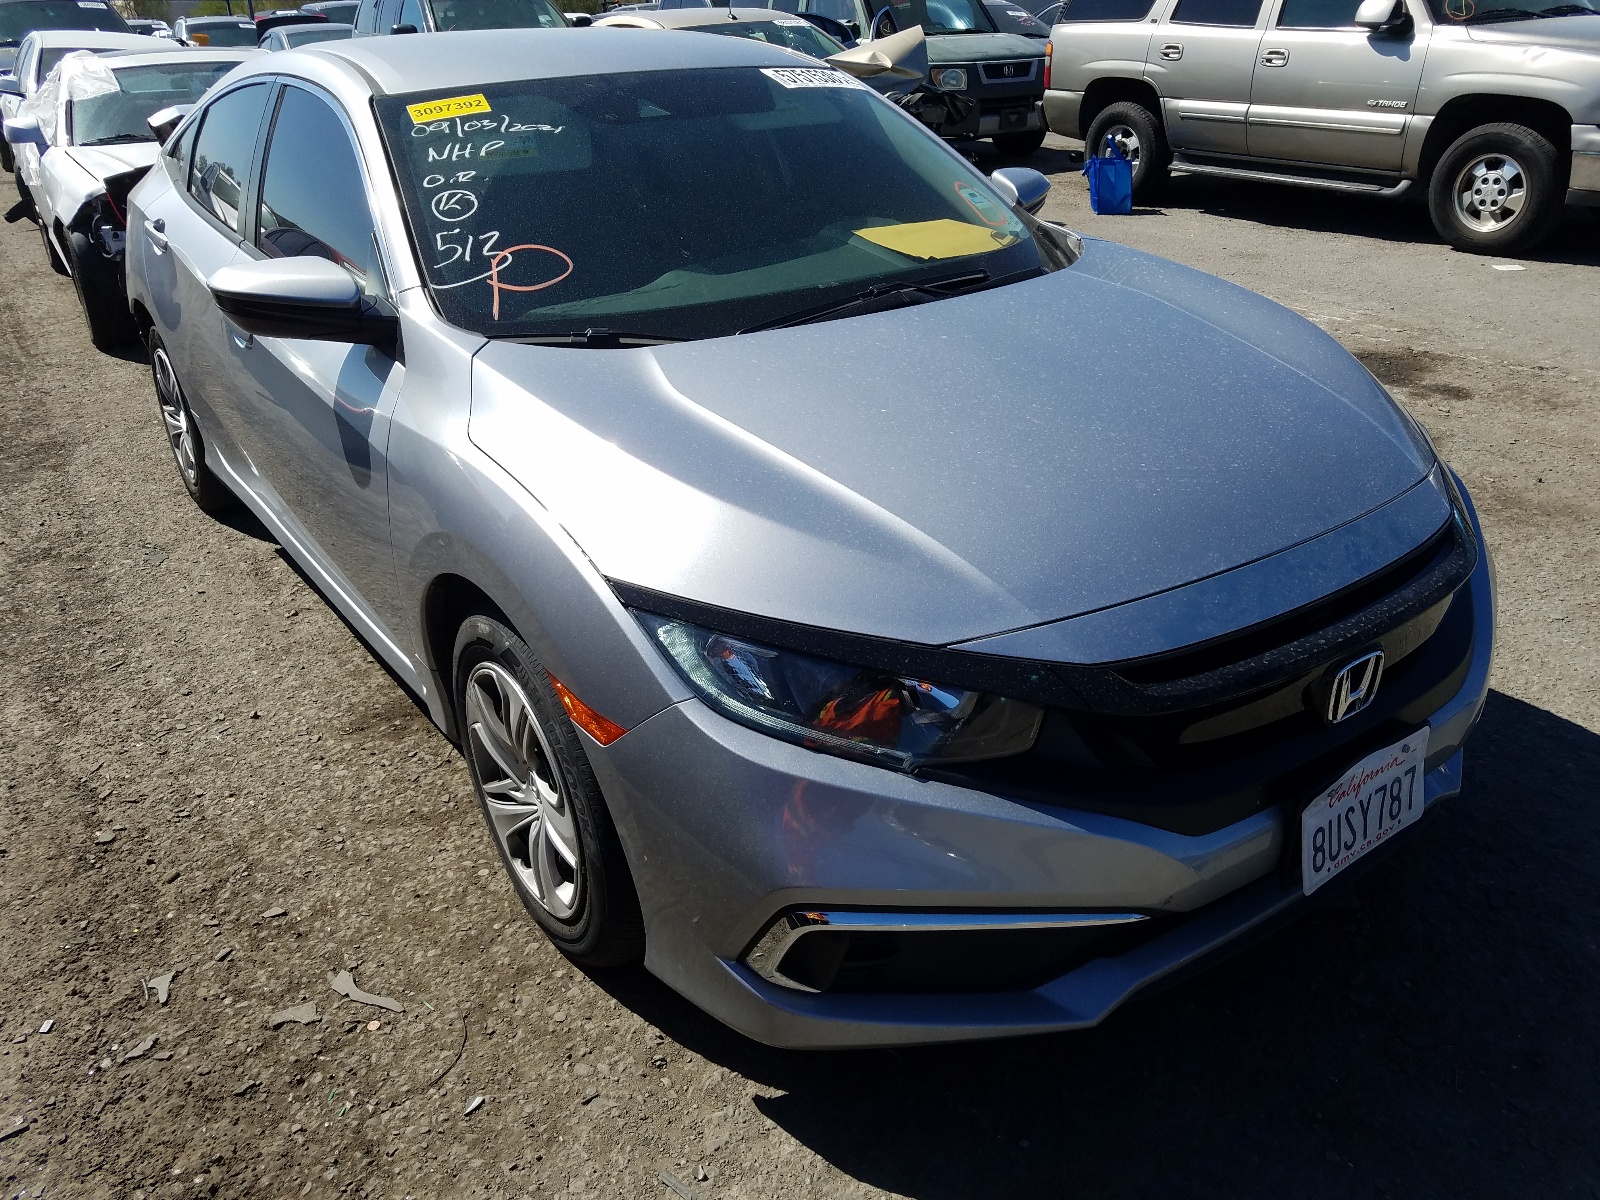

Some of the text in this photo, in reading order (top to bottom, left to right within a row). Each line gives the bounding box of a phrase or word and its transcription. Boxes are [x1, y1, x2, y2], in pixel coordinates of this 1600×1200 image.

[413, 99, 484, 117] 3097392
[1378, 99, 1408, 108] TAHOE
[1328, 756, 1406, 808] California
[1312, 764, 1416, 873] 8USY787
[1333, 823, 1395, 869] dmv.ca.gov
